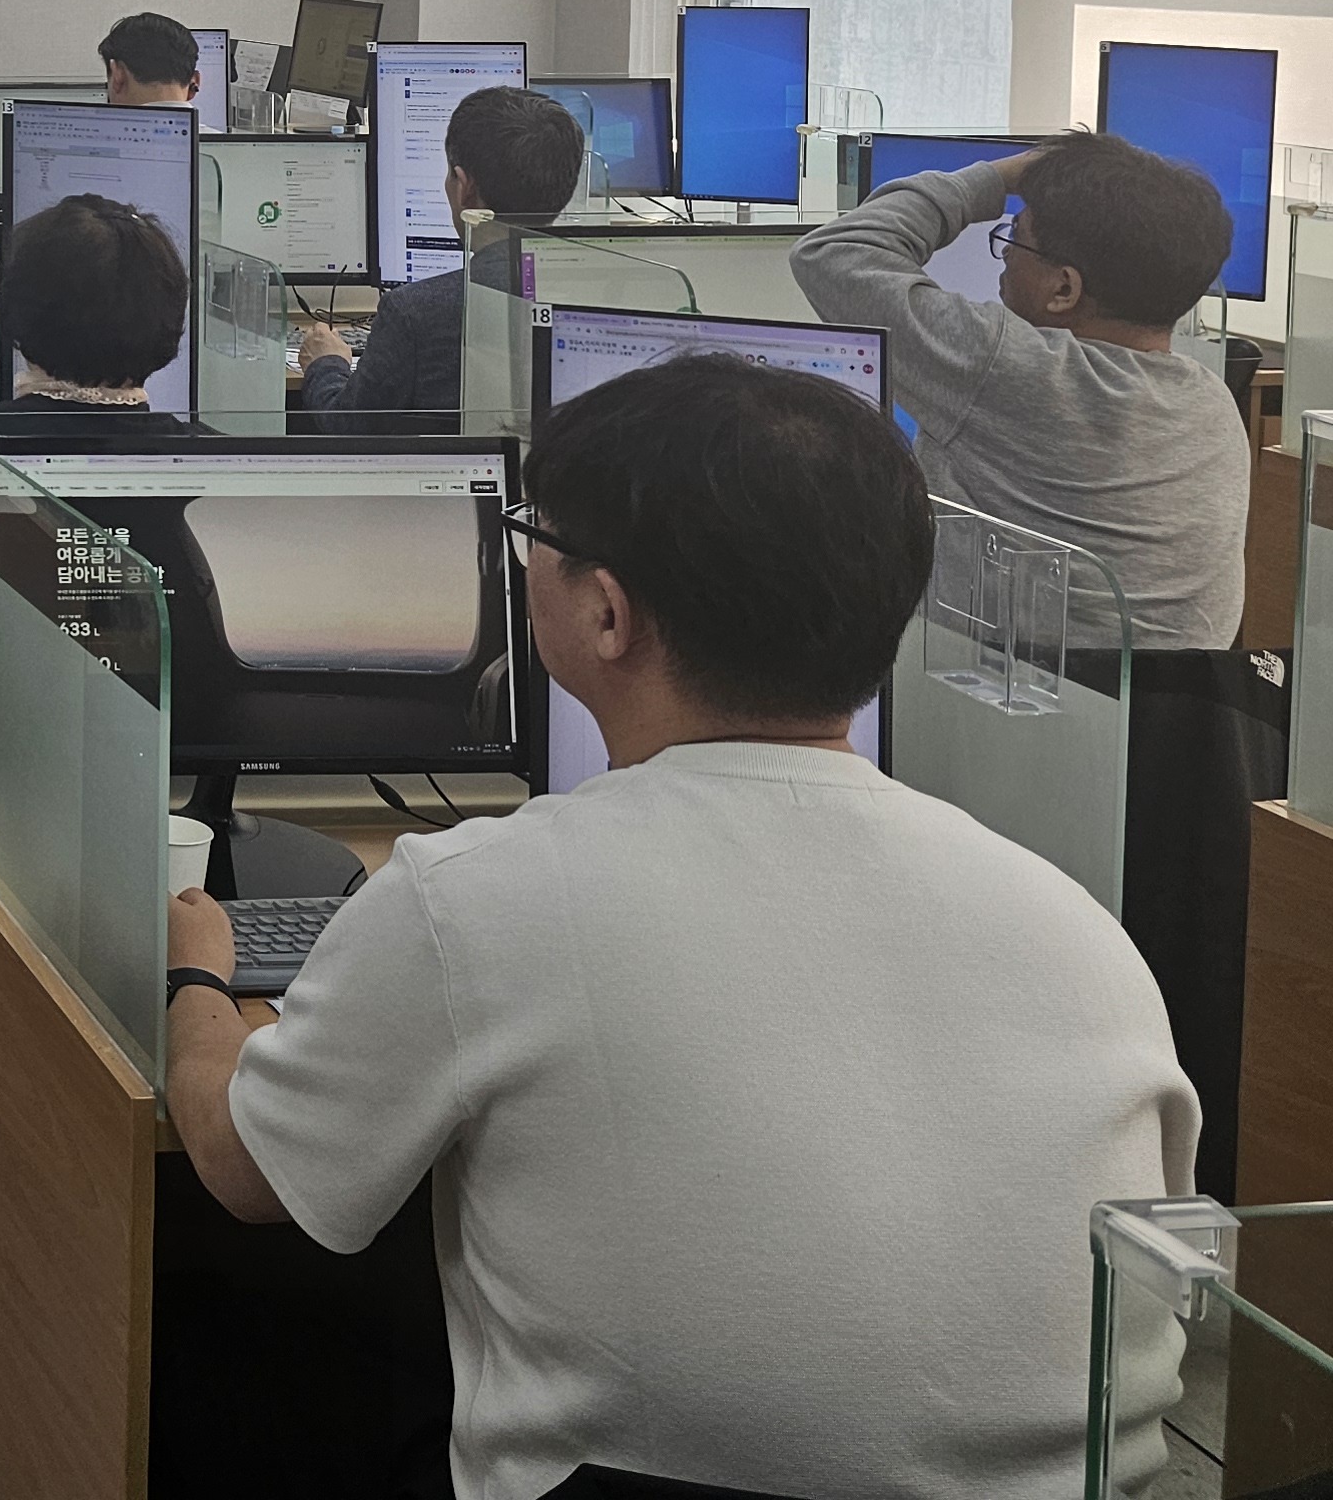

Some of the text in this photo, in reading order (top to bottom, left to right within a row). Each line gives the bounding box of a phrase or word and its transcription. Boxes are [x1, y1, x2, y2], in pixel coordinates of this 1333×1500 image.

[2, 102, 12, 112] 13
[859, 135, 871, 145] 12
[532, 307, 550, 323] 18
[56, 527, 89, 545] 모든
[56, 546, 121, 564] 여유롭게
[57, 566, 123, 584] 담아내는
[59, 622, 101, 636] 633 L
[1250, 654, 1274, 671] NORTH
[1262, 649, 1278, 665] THE
[1256, 667, 1274, 681] FACE
[240, 762, 280, 770] SAMSUNG
